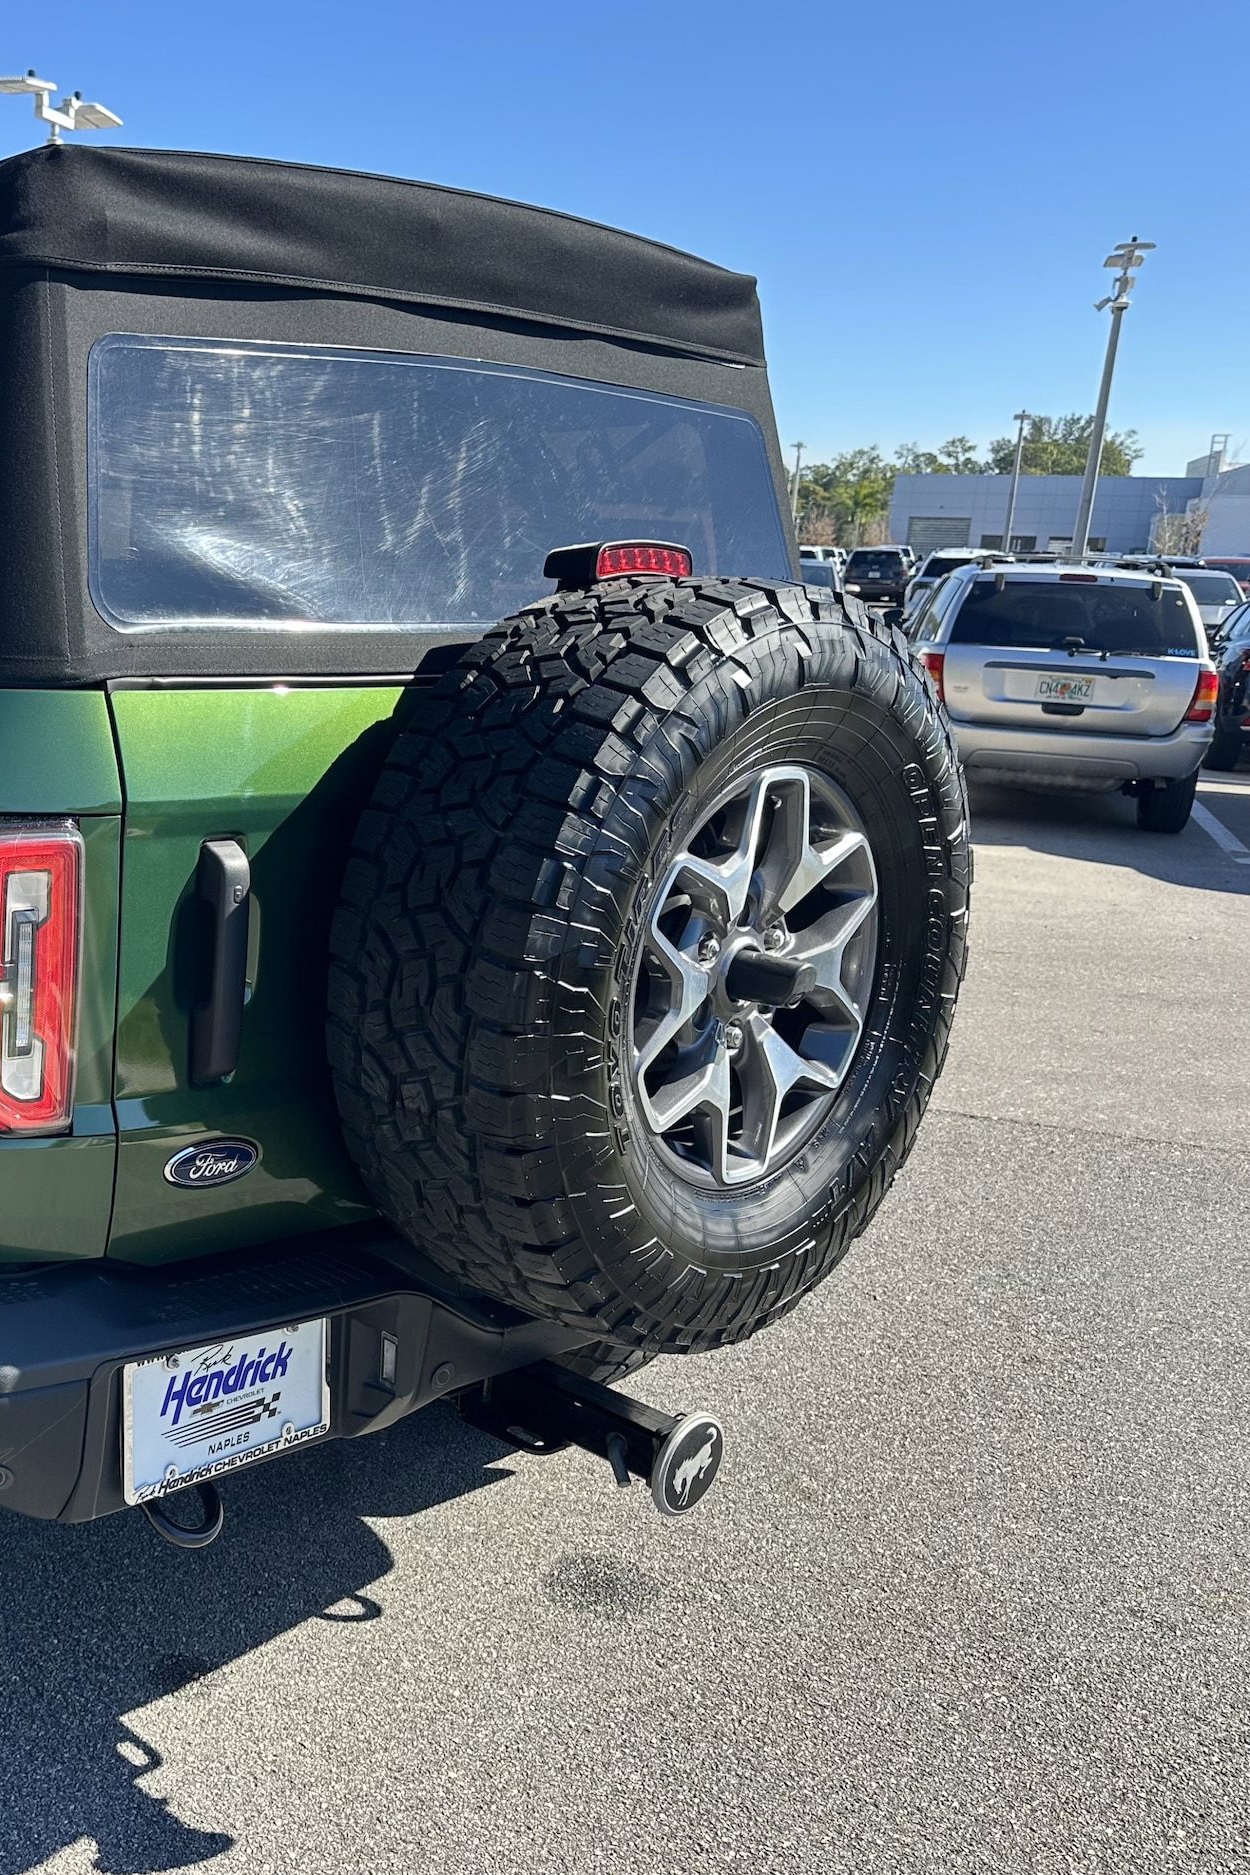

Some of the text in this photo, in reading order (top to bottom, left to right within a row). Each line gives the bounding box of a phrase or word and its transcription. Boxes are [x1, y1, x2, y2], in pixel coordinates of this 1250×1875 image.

[189, 1152, 239, 1179] Ford
[159, 1341, 293, 1426] Hendrick
[226, 1387, 265, 1405] CHEVROLET
[207, 1431, 251, 1456] NAPLES
[157, 1463, 214, 1496] Hendrick
[214, 1440, 281, 1473] CHEVROLET
[283, 1423, 328, 1447] NAPLES
